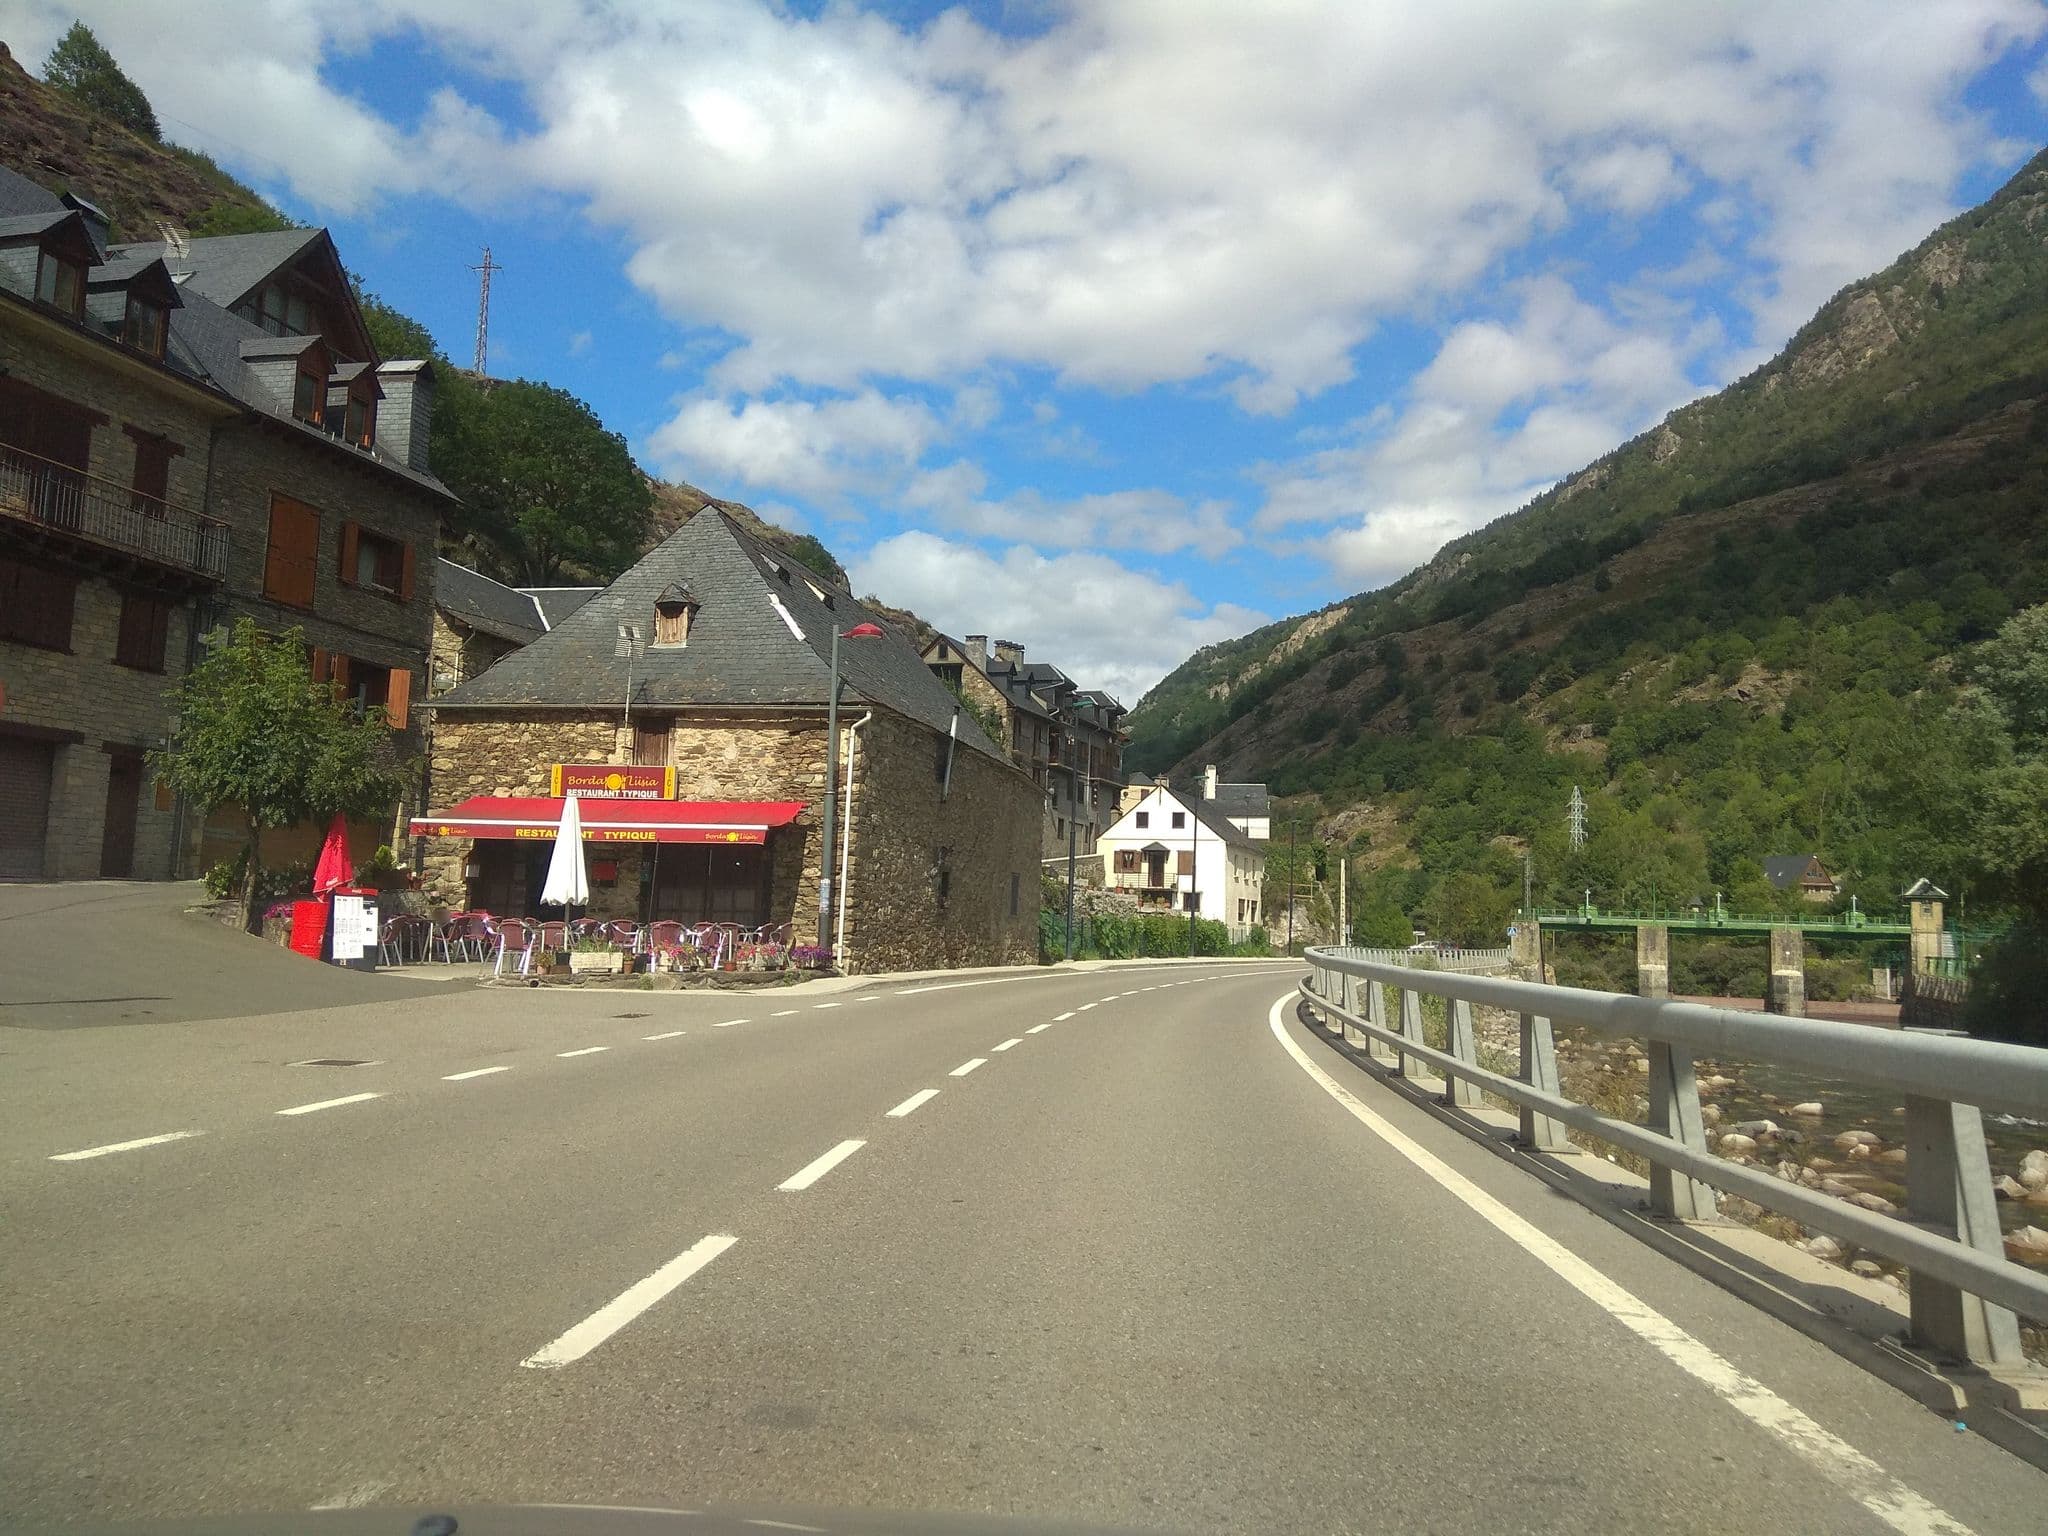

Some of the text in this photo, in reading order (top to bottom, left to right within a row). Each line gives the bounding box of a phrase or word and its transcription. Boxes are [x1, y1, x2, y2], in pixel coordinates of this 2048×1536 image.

[567, 775, 606, 785] Borda
[566, 789, 658, 799] RESTAURANT TYPIQUE
[604, 831, 656, 840] TYPIQUE
